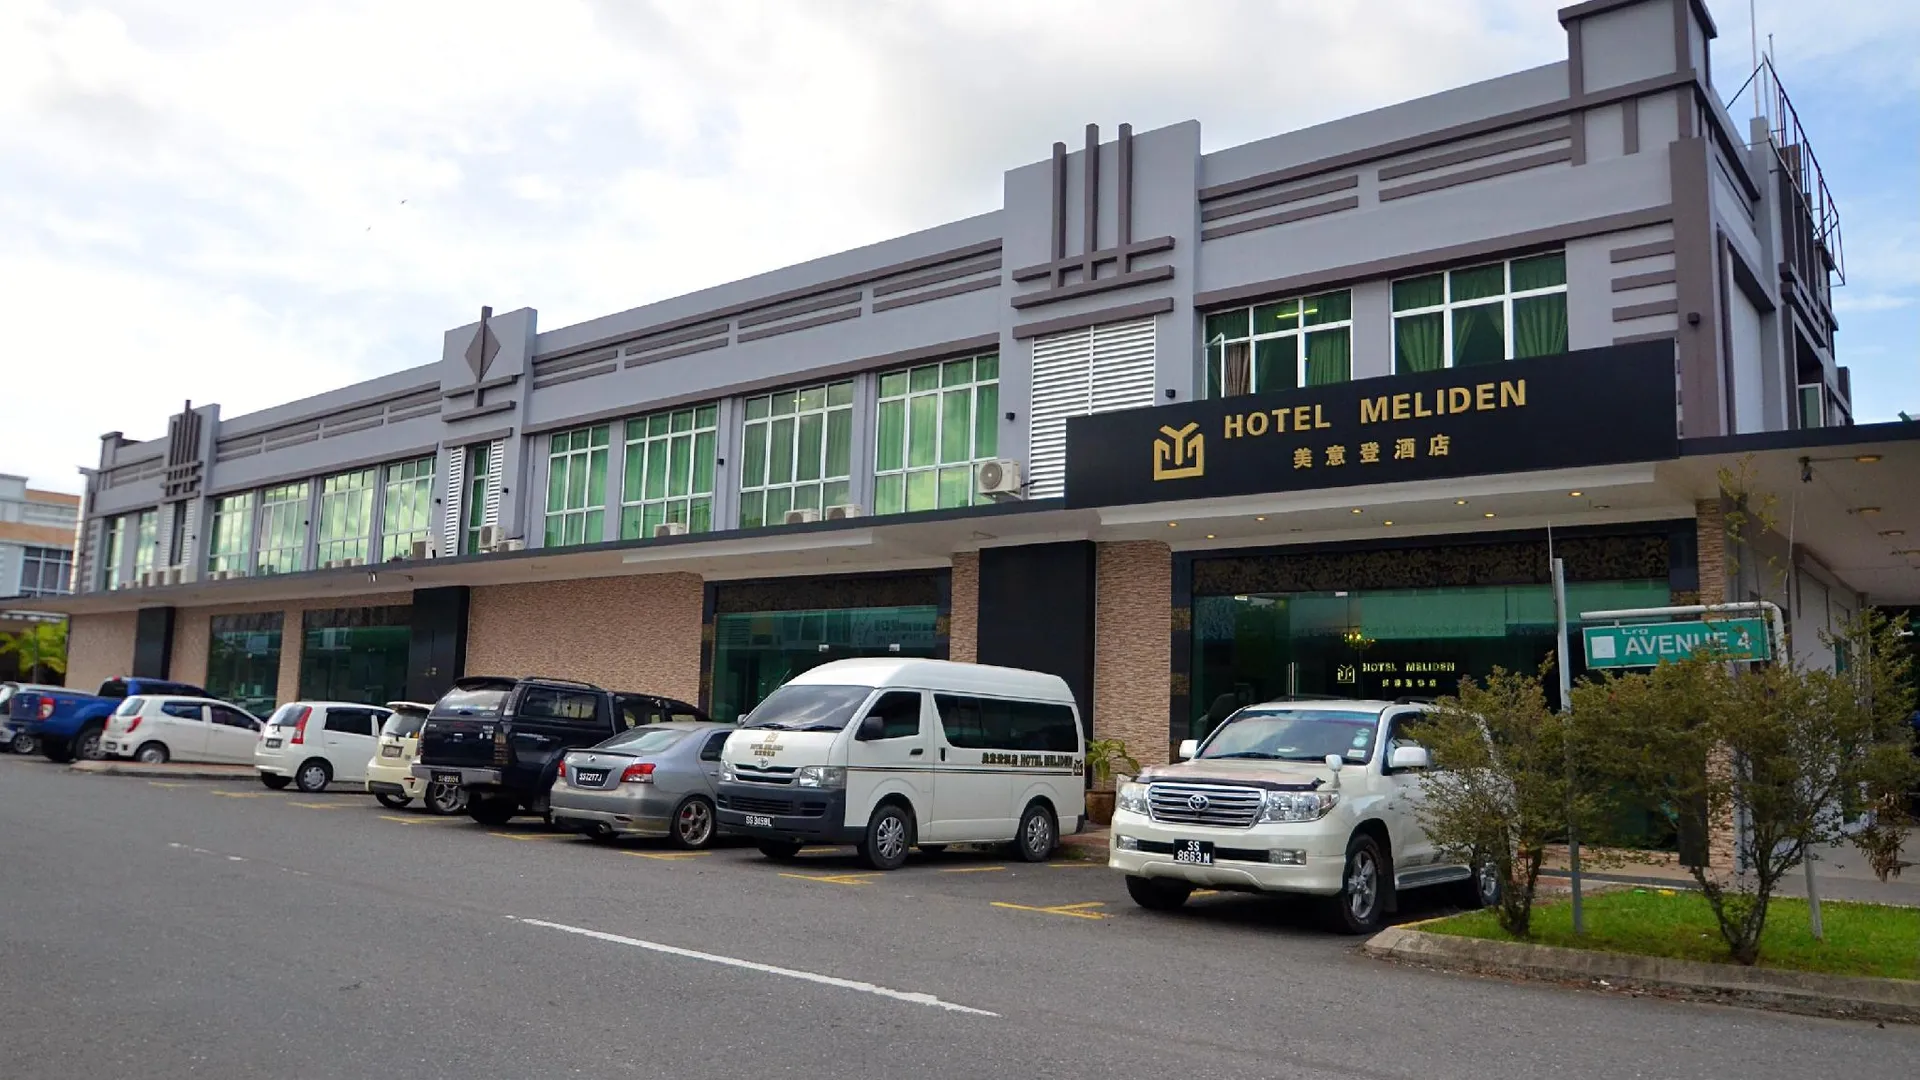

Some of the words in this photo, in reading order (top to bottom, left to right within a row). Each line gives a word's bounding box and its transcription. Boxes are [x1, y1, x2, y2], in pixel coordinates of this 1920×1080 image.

[1224, 404, 1332, 439] HOTEL
[1360, 379, 1527, 424] MELIDEN
[1293, 434, 1450, 469] 美意登酒店
[1737, 631, 1752, 650] 4
[1362, 662, 1397, 672] HOTEL
[1405, 662, 1455, 672] MELIDEN
[1187, 840, 1200, 851] SS
